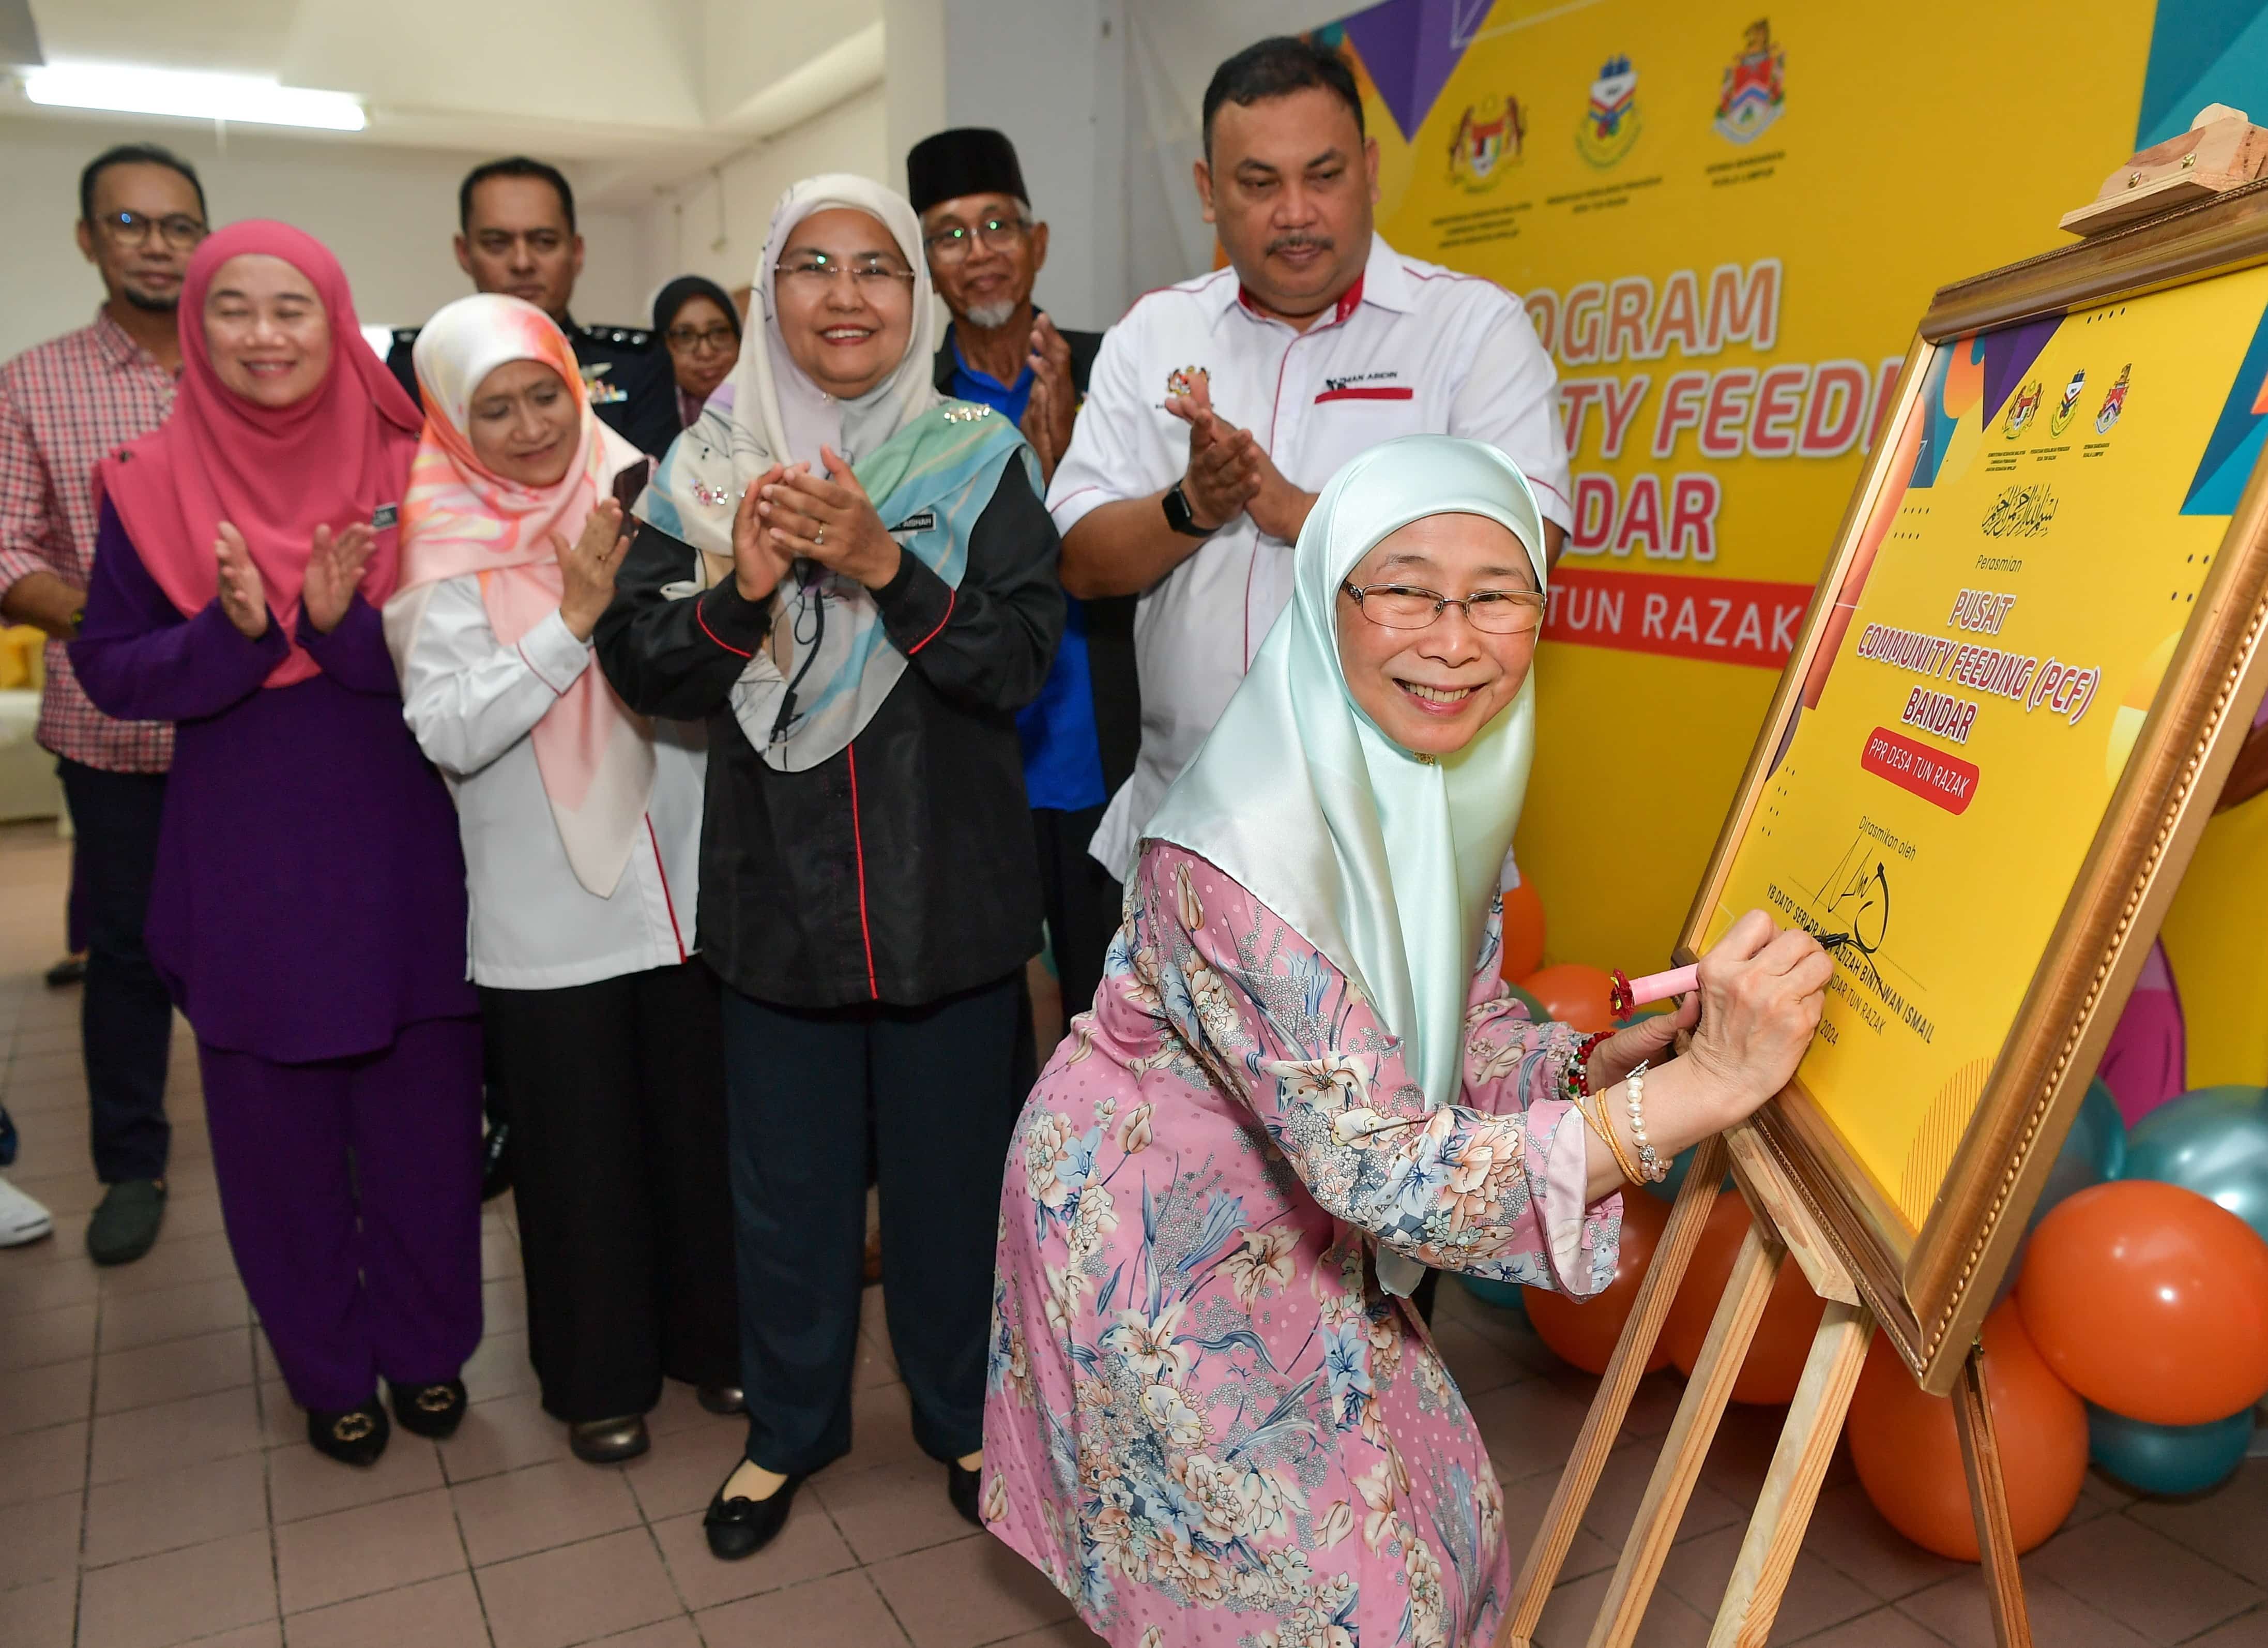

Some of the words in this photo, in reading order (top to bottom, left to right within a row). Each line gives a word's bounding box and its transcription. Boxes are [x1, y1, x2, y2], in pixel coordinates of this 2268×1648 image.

[1975, 554, 2022, 572] Perasmian
[1547, 584, 1624, 634] TUN
[1642, 593, 1801, 653] RAZAK
[1947, 588, 2015, 635] PUSAT
[1856, 622, 1958, 678] COMMUNITY
[1947, 643, 2037, 701] FEEDING
[2027, 656, 2100, 725] (PCF)
[1901, 685, 1978, 745] BANDAR
[1868, 738, 1888, 761] PPR
[1887, 746, 1912, 773] DESA
[1912, 757, 1935, 781] TUN
[1932, 766, 1970, 798] RAZAK
[1859, 815, 1898, 851] Dirasmikan
[1898, 841, 1916, 861] oleh
[1767, 883, 1776, 900] YB
[1774, 890, 1795, 914] DATO'
[1833, 942, 1862, 976] AZIZAH
[1883, 984, 1904, 1016] WAN
[1902, 1004, 1935, 1044] ISMAIL
[1820, 1019, 1839, 1047] 2024
[1846, 988, 1862, 1012] TUN
[1860, 1003, 1886, 1036] RAZAK
